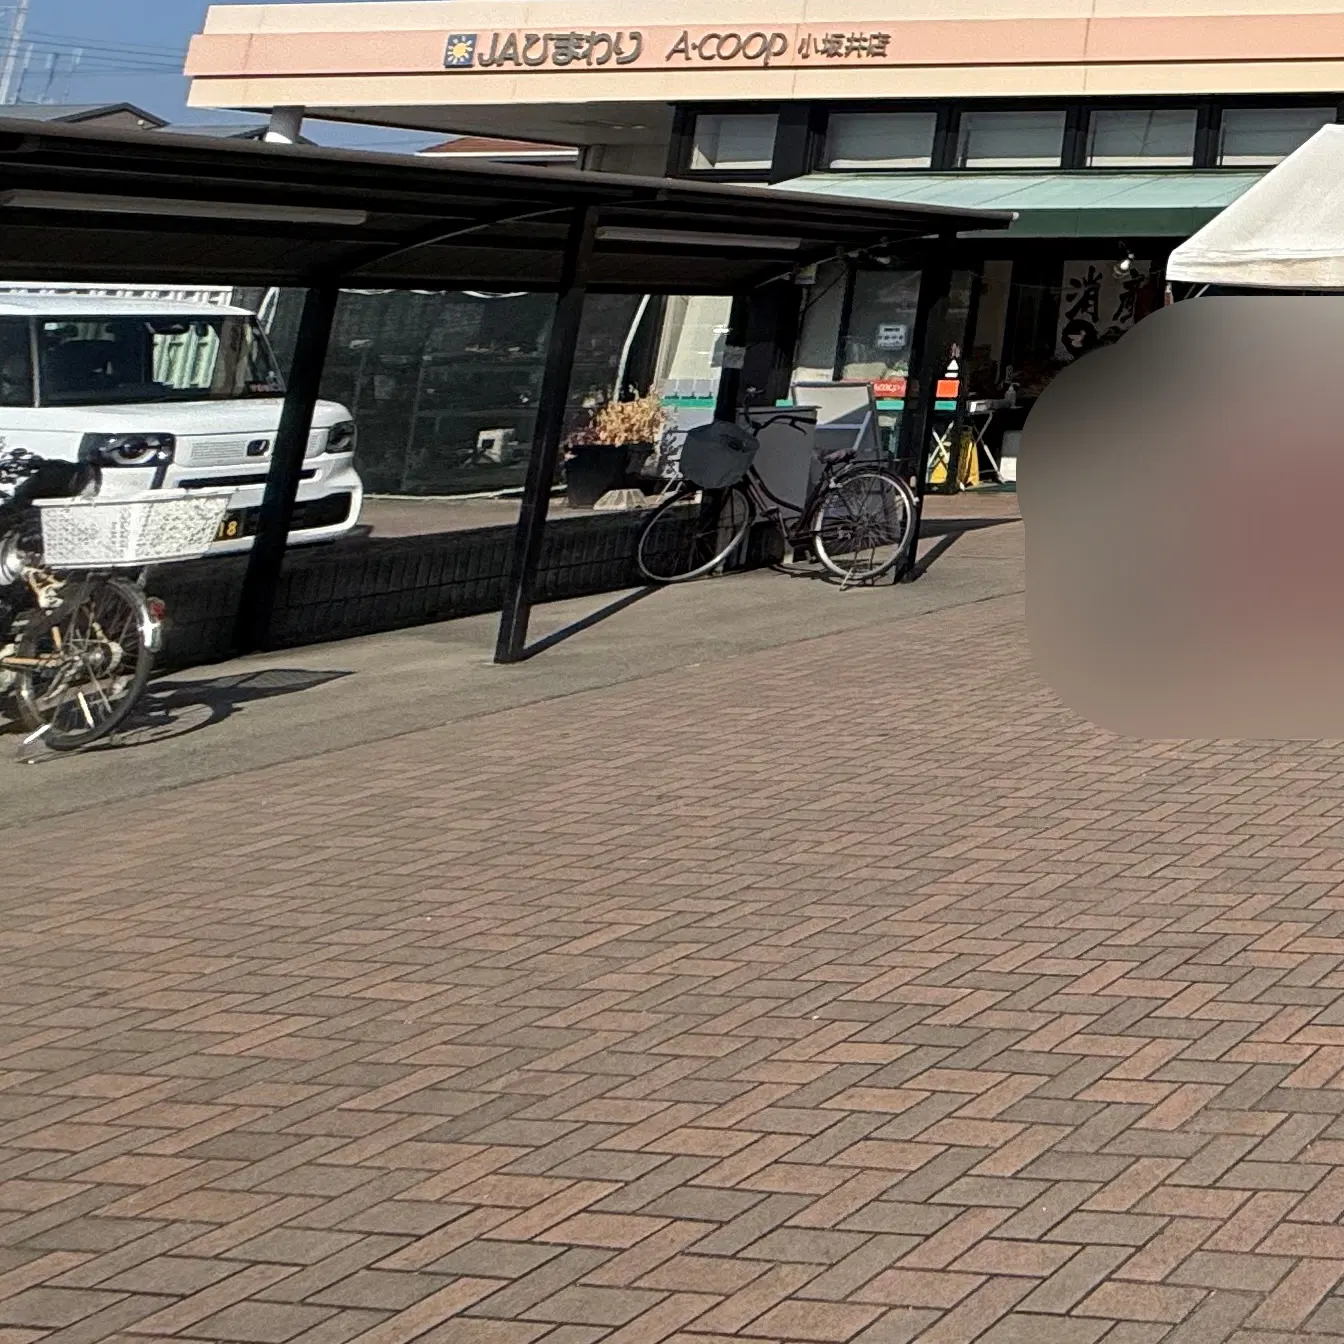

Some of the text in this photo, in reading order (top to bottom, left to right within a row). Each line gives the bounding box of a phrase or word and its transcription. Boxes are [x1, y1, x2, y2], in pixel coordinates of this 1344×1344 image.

[477, 31, 642, 67] JAひまわり
[797, 32, 892, 59] 小坂井店
